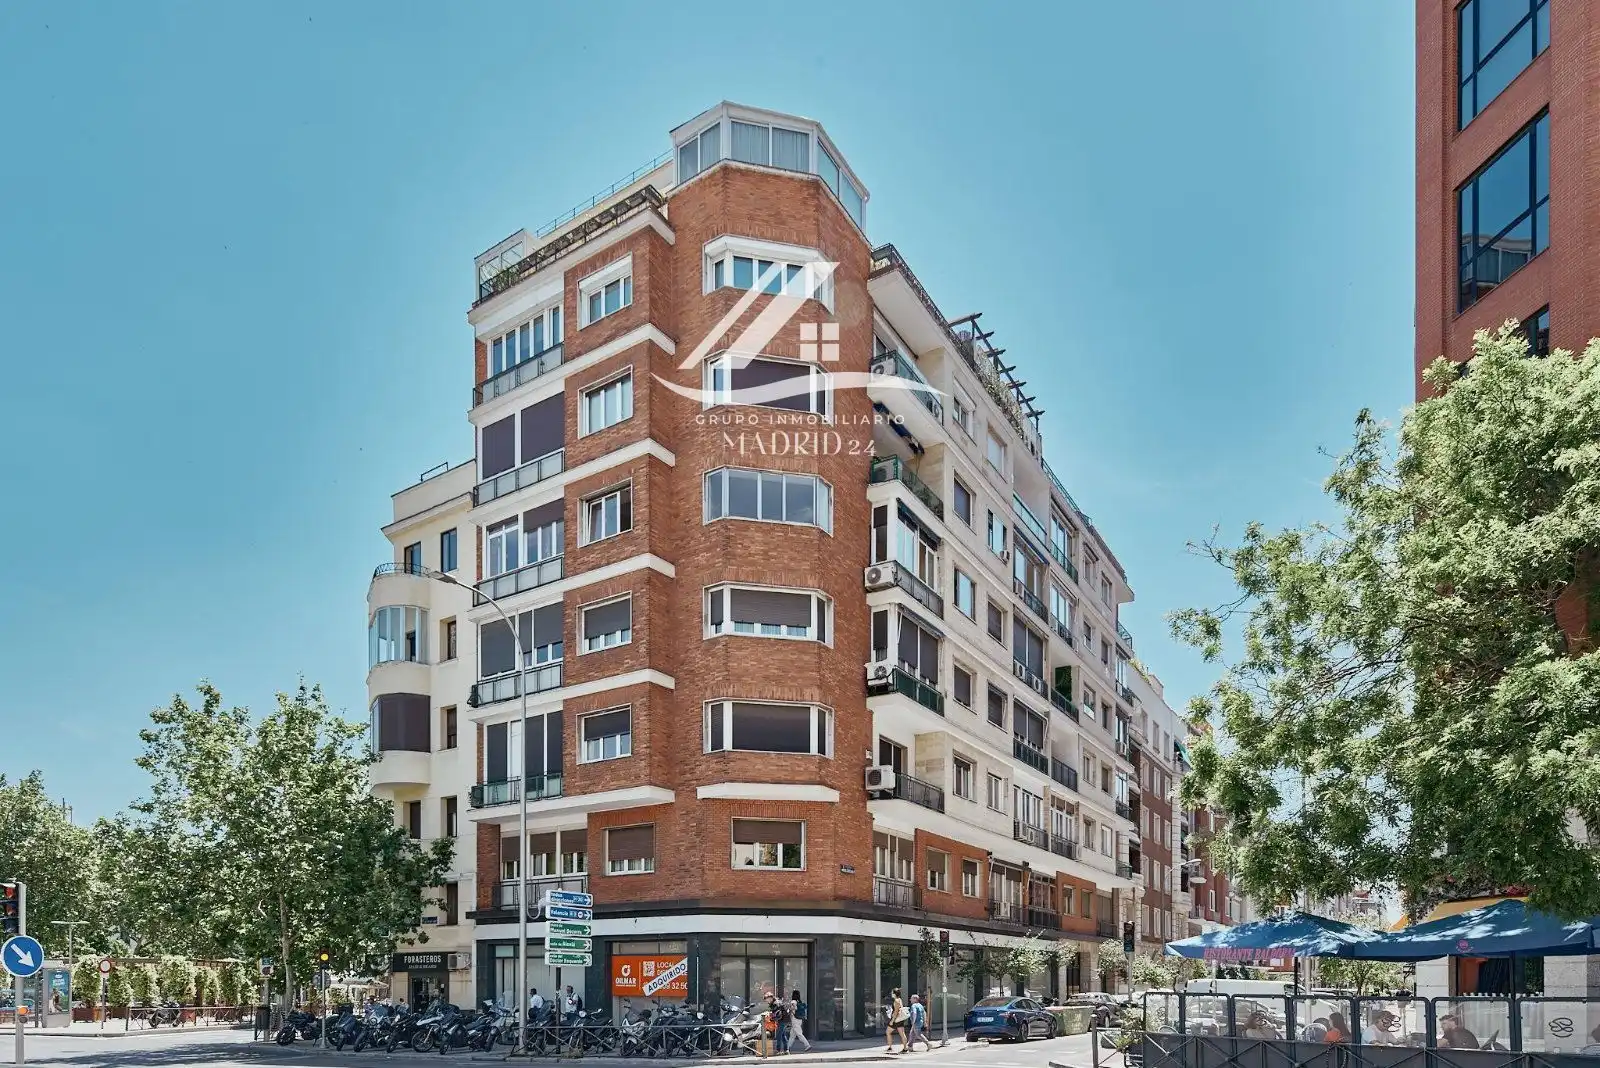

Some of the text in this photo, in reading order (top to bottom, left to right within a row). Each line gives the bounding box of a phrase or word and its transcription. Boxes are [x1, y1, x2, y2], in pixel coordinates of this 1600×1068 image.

[404, 955, 442, 964] FORASTEROS
[1204, 948, 1254, 960] RISTORANTE
[648, 963, 686, 993] ADQUIRIDO
